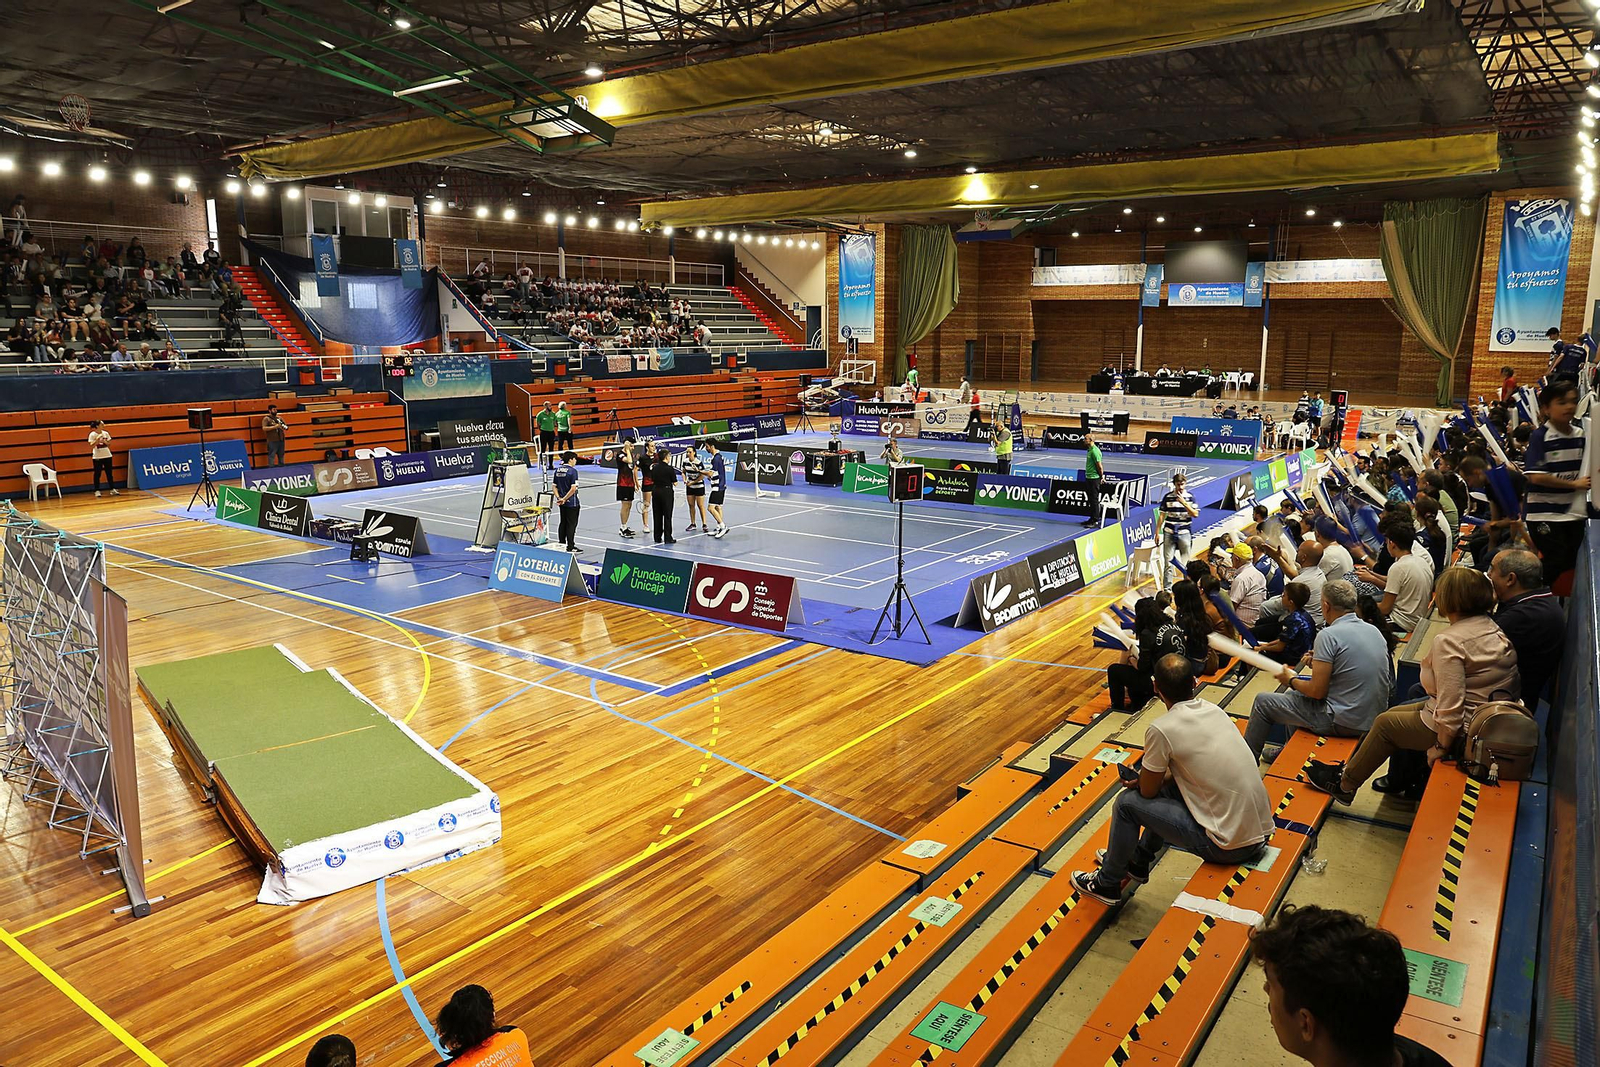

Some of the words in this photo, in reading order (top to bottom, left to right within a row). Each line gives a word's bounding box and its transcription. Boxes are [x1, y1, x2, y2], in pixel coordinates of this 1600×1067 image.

[1507, 268, 1560, 283] Apoyamos
[1520, 278, 1558, 292] esfuerzo
[858, 406, 888, 414] Huelva
[455, 423, 484, 433] Huelva
[486, 420, 504, 431] eleva
[760, 418, 782, 429] Huelva
[456, 436, 470, 444] tus
[472, 433, 504, 442] sentidos
[977, 428, 990, 438] bu
[1220, 443, 1252, 455] YONEX
[435, 452, 475, 467] Huelva
[143, 459, 192, 476] Huelva
[396, 466, 426, 476] HUELVA
[274, 474, 314, 491] YONEX
[908, 475, 917, 492] 0
[1006, 486, 1046, 503] YONEX
[1126, 518, 1152, 545] Huelva
[518, 556, 565, 575] LOTERÍAS
[1091, 555, 1122, 577] IBERDROLA
[536, 575, 557, 584] DEPORTE
[632, 566, 681, 585] Fundación
[630, 578, 665, 596] Unicaja
[753, 604, 776, 613] Superior
[754, 596, 776, 607] Consejo
[759, 611, 783, 622] Deportes
[994, 597, 1038, 626] BADMINTON
[346, 840, 381, 852] Ayuntamiento
[364, 843, 382, 852] Huelva
[286, 858, 322, 872] Ayuntamiento
[305, 861, 323, 870] Huelva
[1426, 960, 1450, 997] SIÉNTESE
[929, 1013, 949, 1031] AQUÍ
[940, 1013, 972, 1044] SIÉNTESE
[476, 1049, 507, 1067] TECCION
